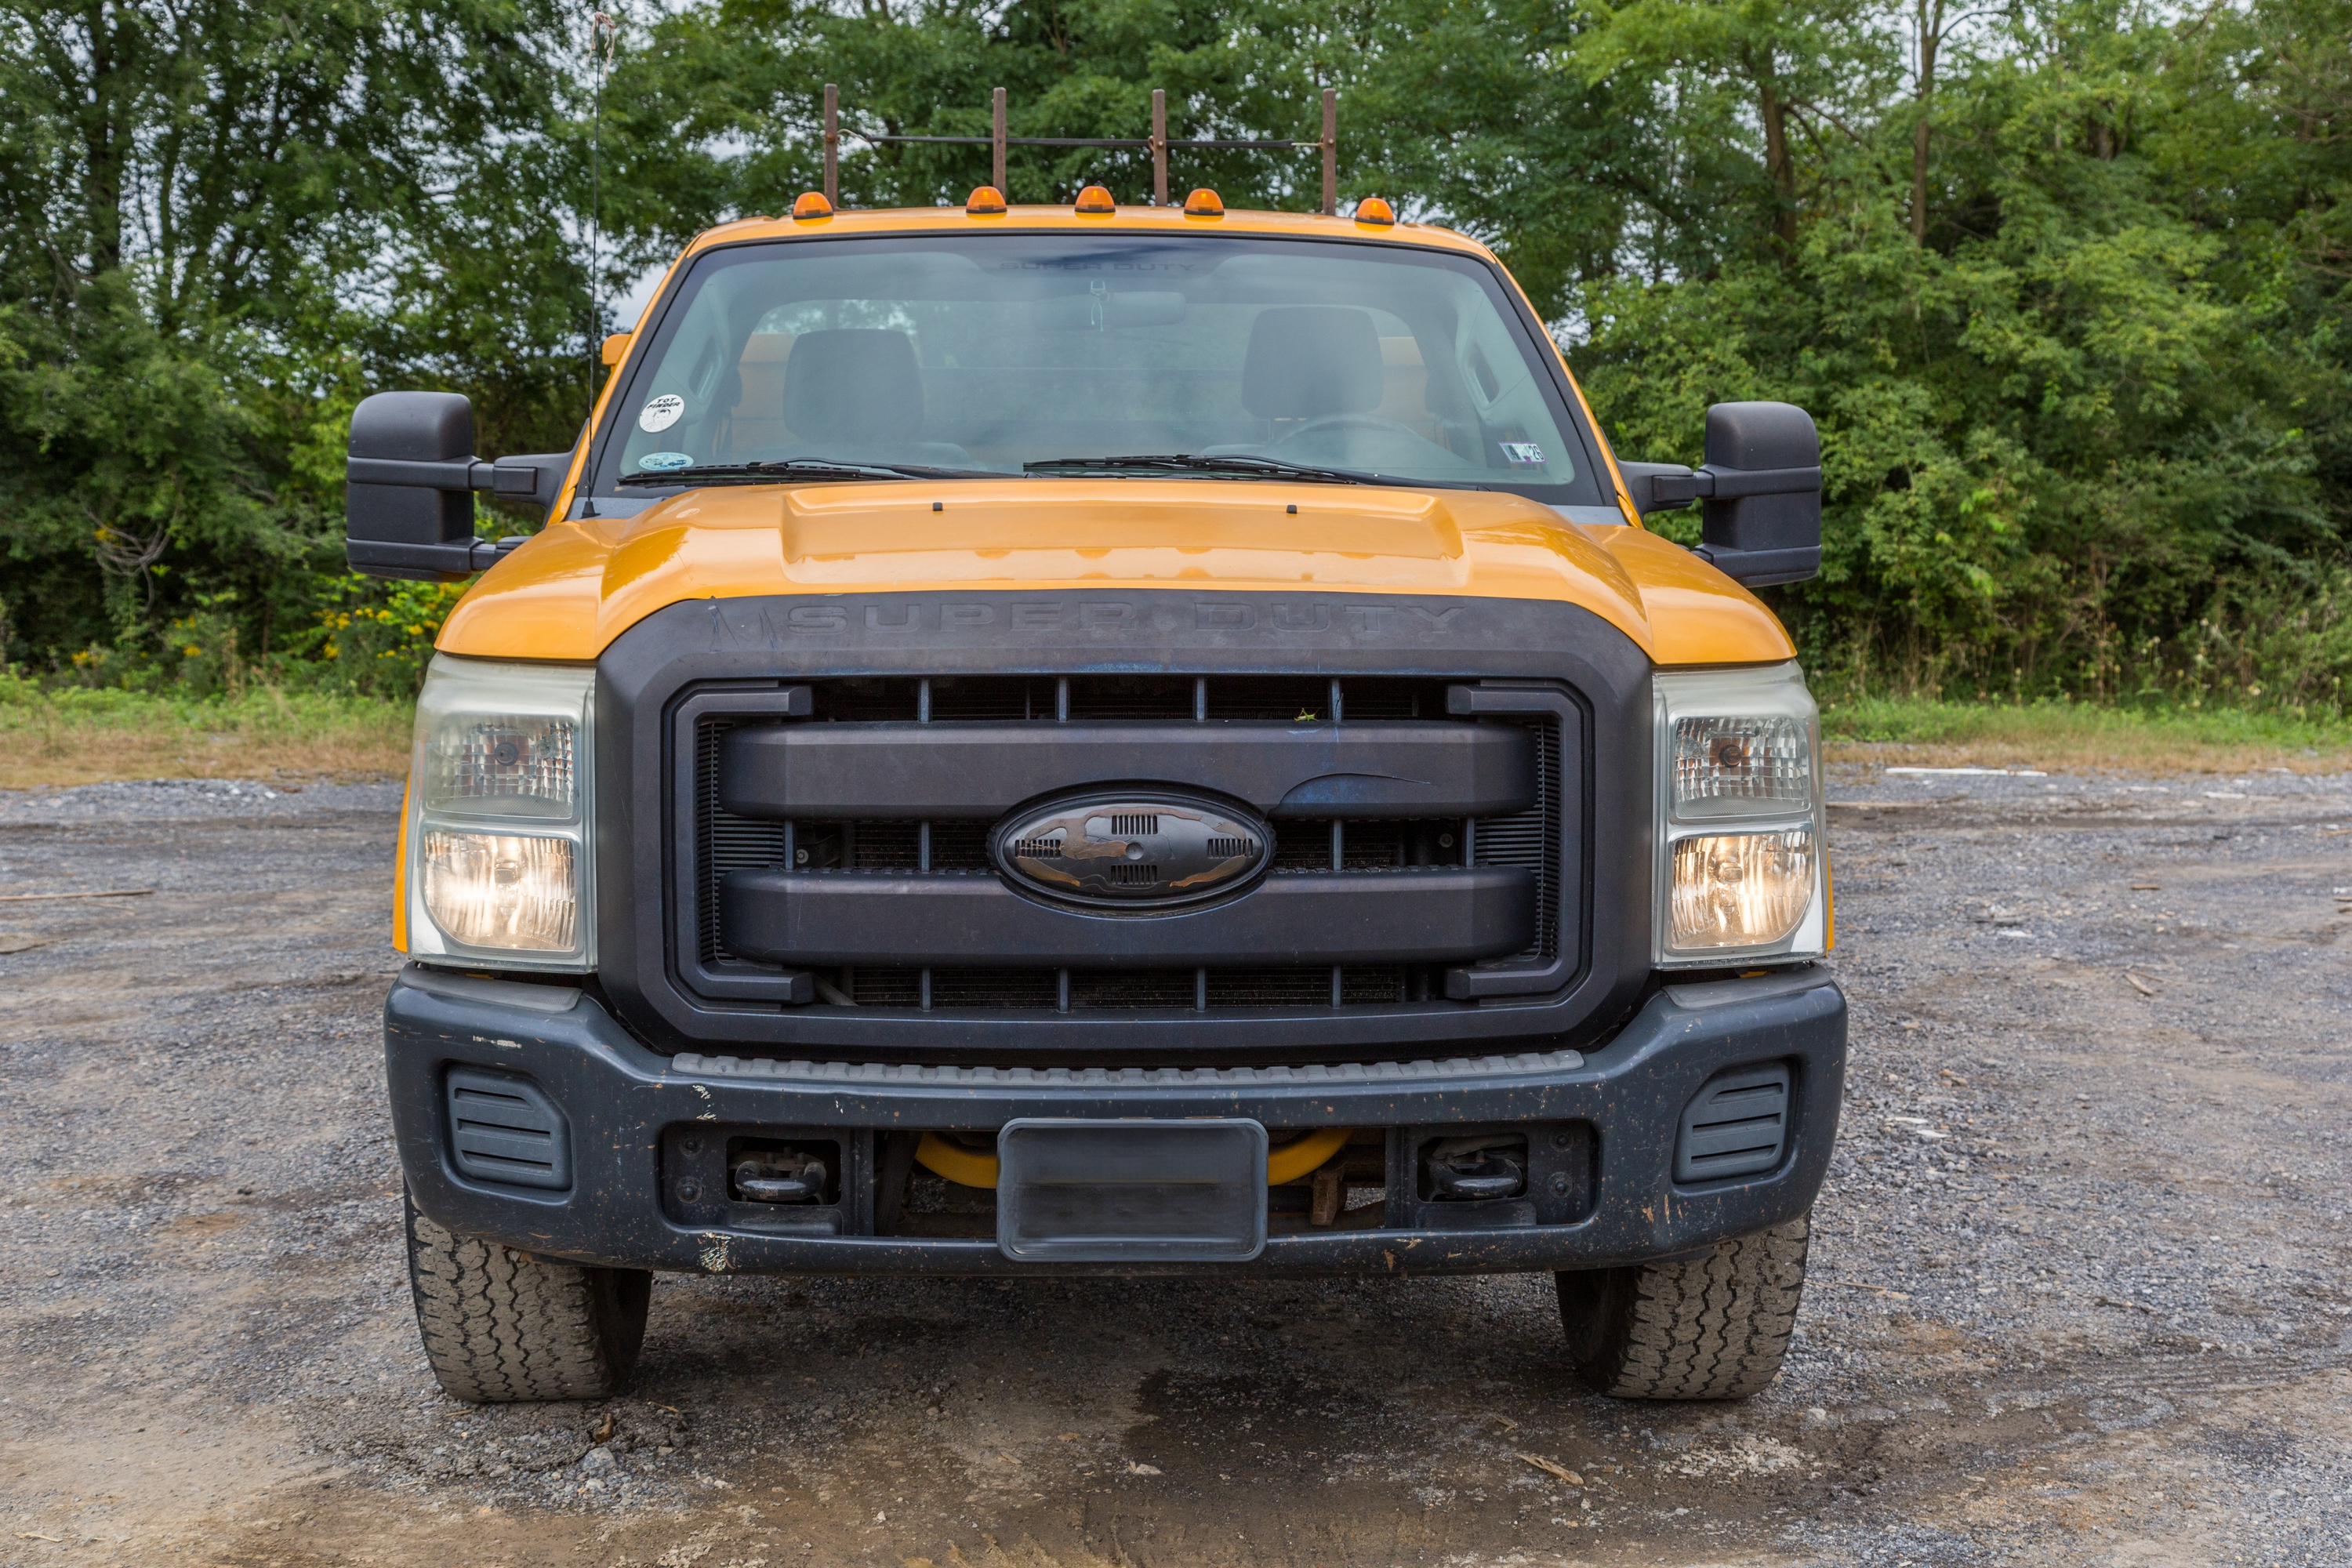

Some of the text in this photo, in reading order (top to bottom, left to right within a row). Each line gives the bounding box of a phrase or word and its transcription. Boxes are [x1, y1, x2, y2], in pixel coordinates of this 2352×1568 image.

[1000, 262, 1195, 271] SUPER DUTY
[1528, 445, 1544, 460] 26
[787, 601, 1468, 634] SUPER DUTY
